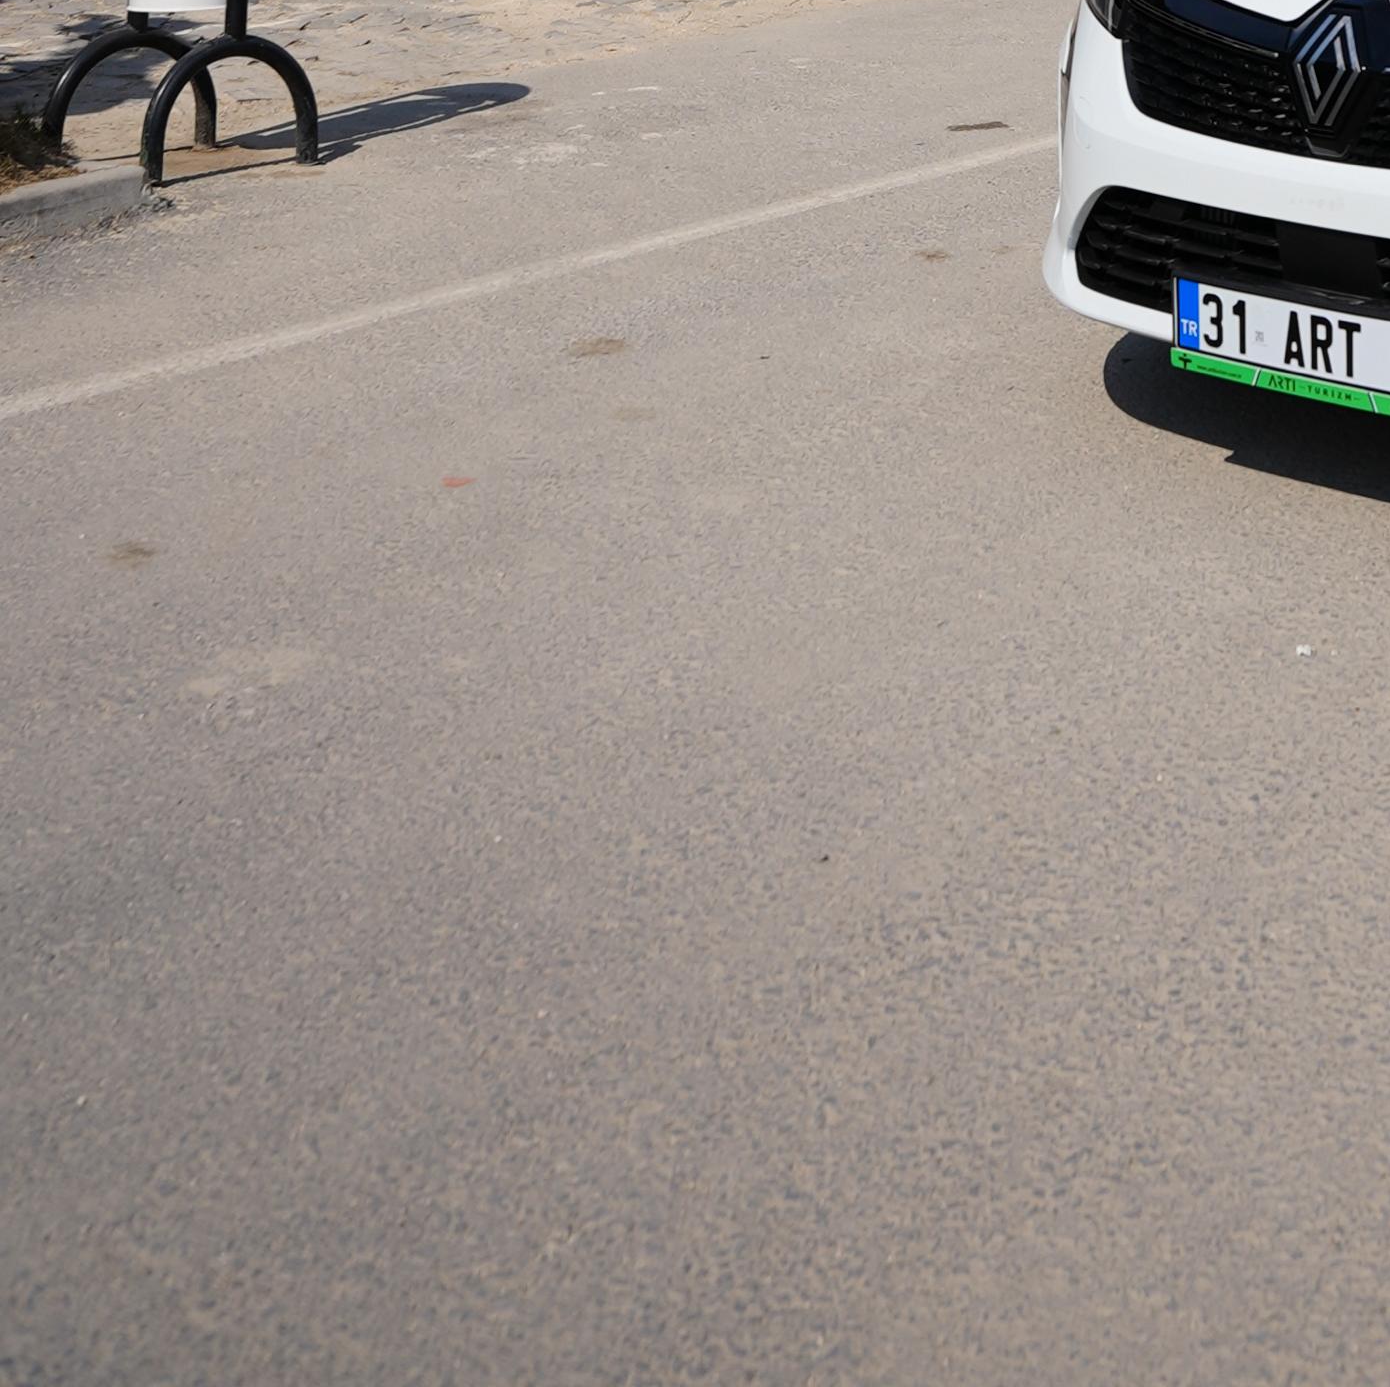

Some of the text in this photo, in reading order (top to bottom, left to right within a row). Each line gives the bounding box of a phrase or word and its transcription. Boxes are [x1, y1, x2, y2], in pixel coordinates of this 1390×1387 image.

[1180, 318, 1198, 337] TR
[1203, 293, 1246, 354] 31
[1284, 310, 1361, 378] ART
